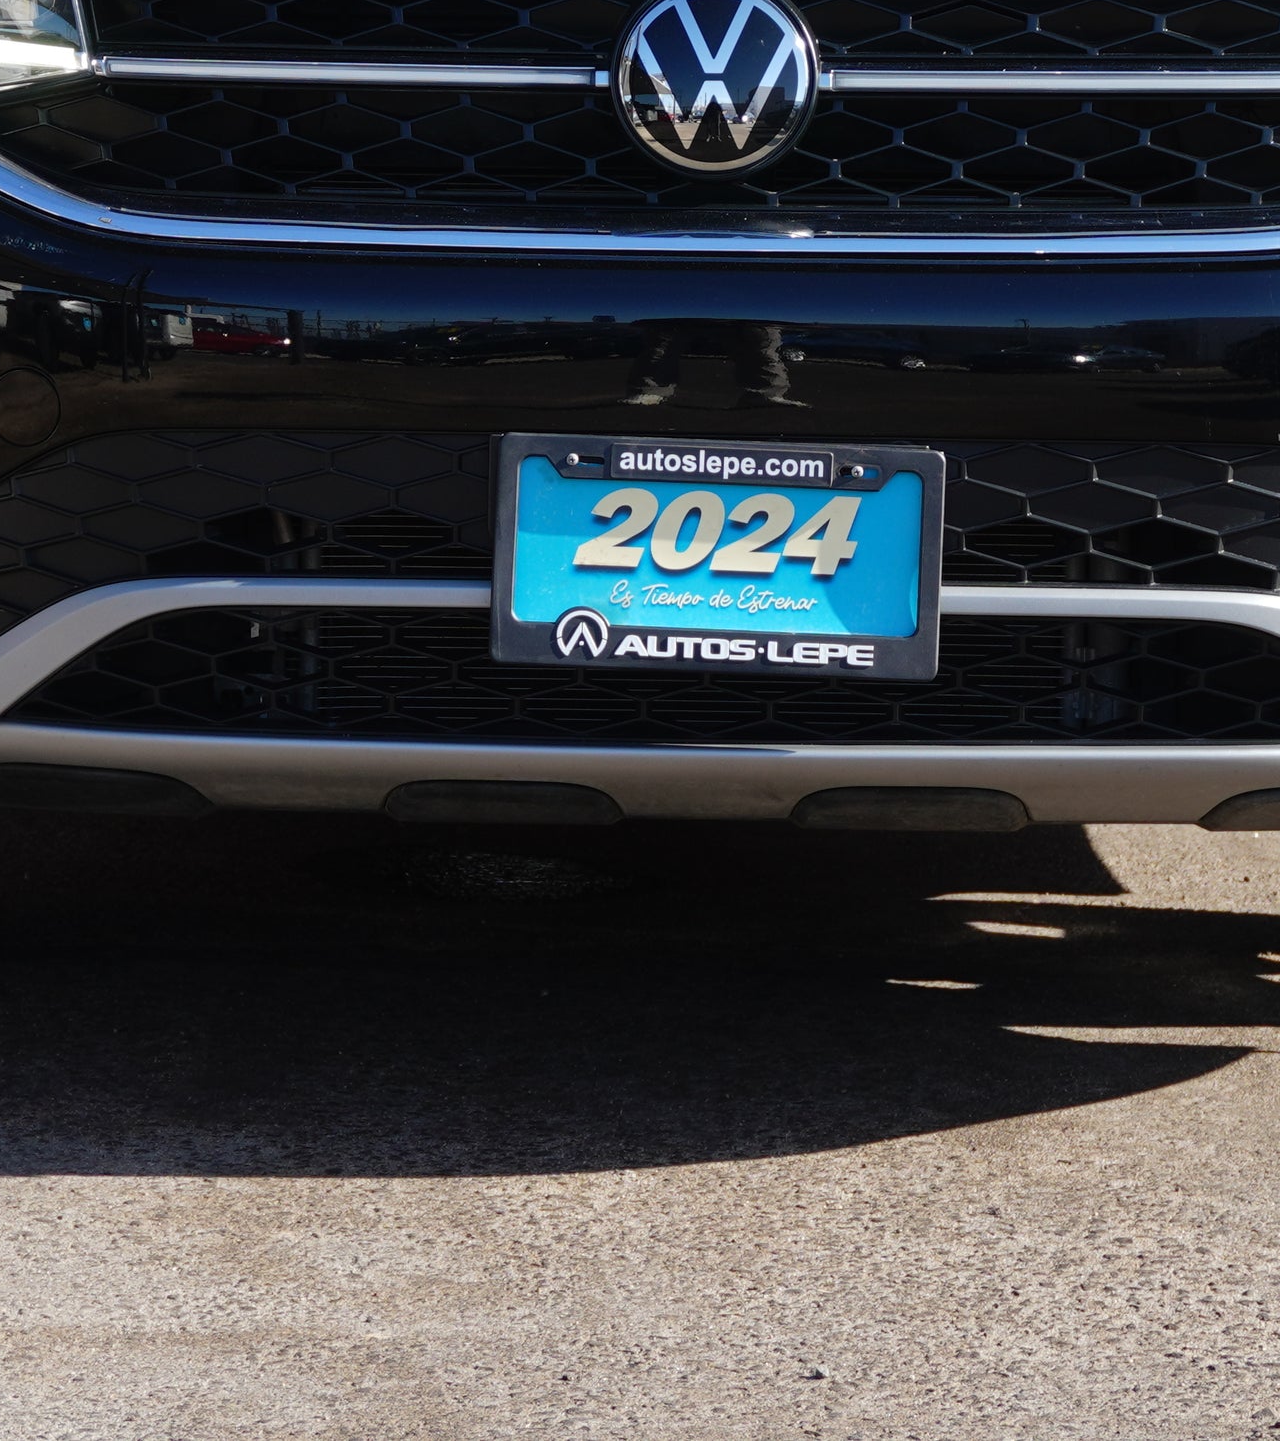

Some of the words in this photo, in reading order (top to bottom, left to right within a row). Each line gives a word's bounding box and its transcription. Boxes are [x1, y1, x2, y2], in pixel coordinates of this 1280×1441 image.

[619, 448, 824, 480] autoslepe.com
[571, 487, 863, 576] 2024
[610, 579, 634, 608] Es
[641, 583, 705, 609] Tiempo
[709, 589, 734, 608] de
[737, 584, 818, 614] Estrenar
